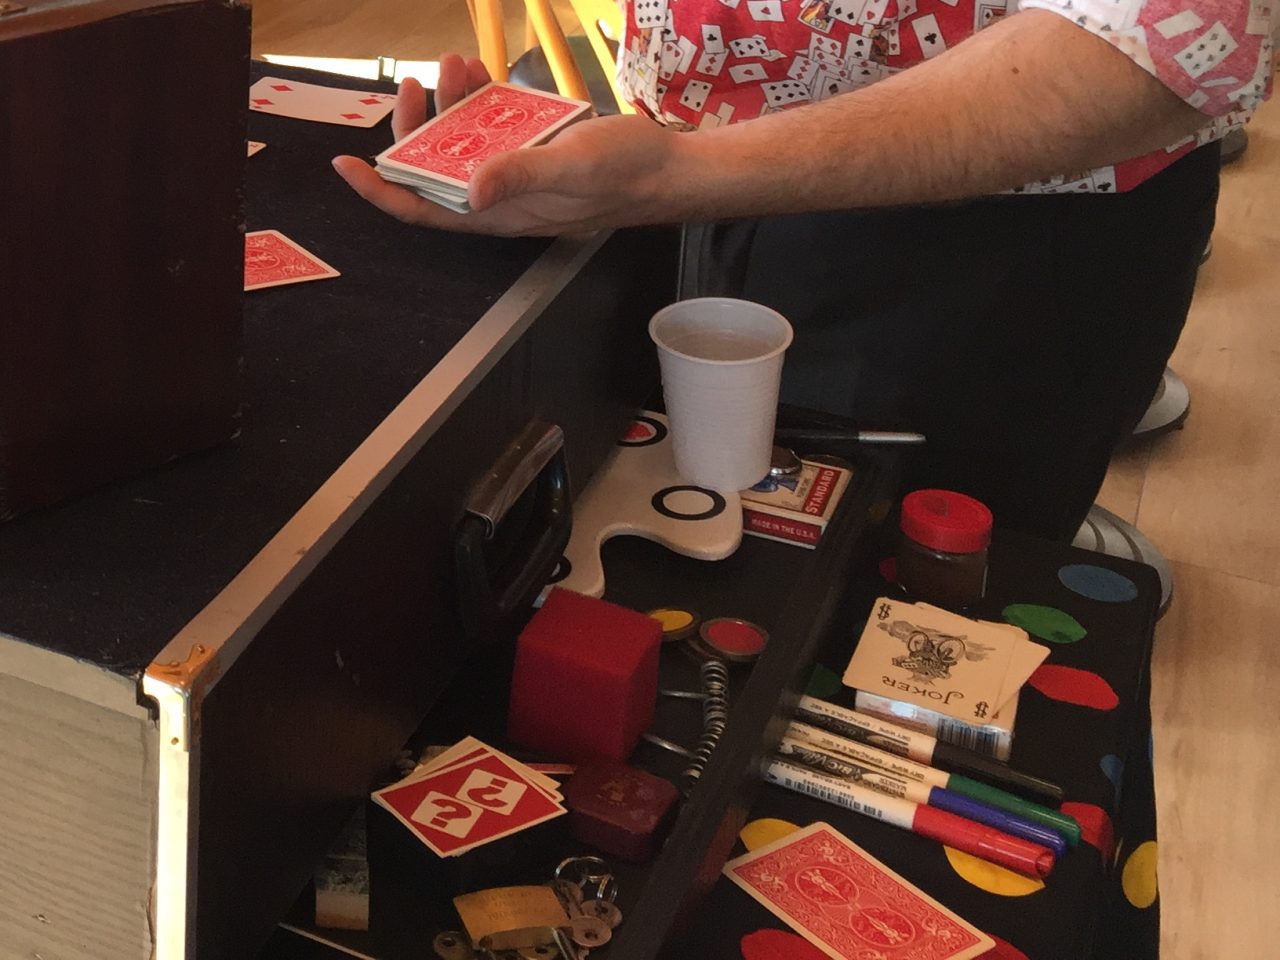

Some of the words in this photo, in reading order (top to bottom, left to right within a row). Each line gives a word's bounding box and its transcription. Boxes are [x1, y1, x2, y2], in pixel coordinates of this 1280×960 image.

[805, 469, 835, 514] STANDARD
[751, 518, 771, 528] MADE
[781, 525, 795, 534] THE
[882, 675, 965, 705] JOKER
